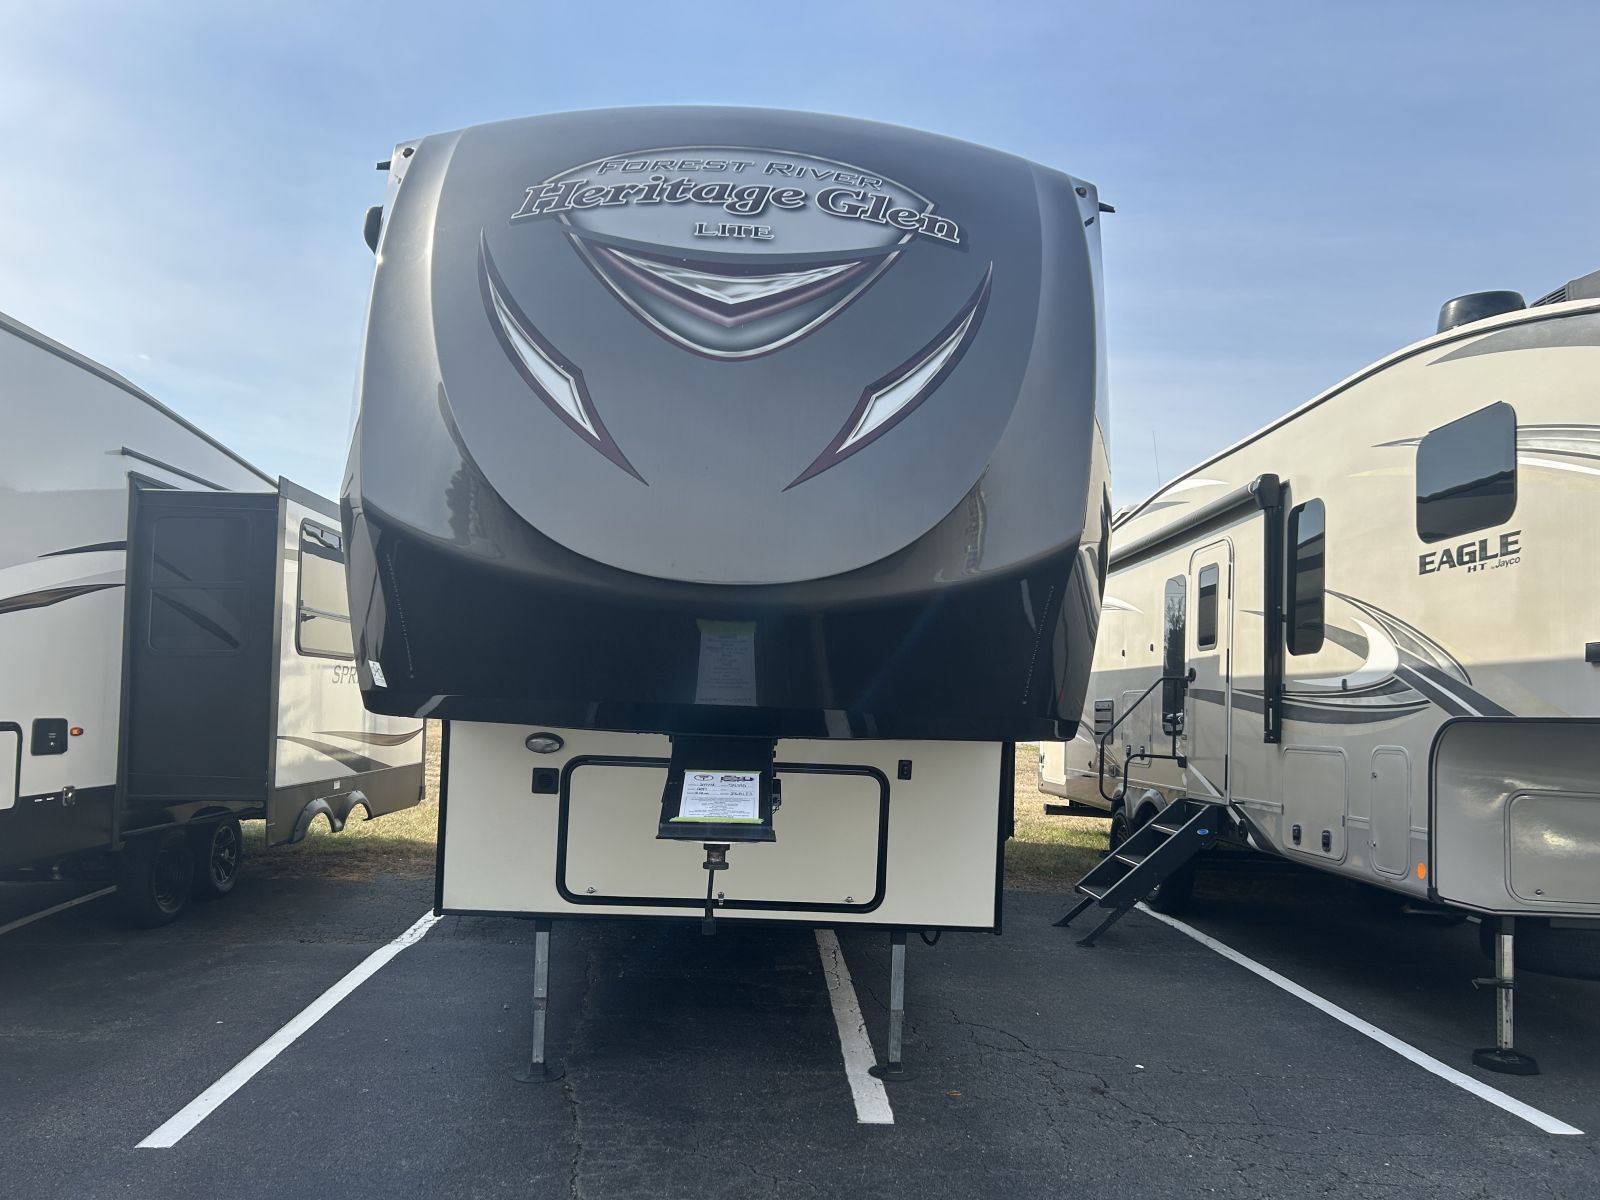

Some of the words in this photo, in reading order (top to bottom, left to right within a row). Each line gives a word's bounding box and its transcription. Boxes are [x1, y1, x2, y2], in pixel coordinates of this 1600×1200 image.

[596, 158, 758, 175] FOREST
[763, 161, 884, 191] RIVER
[510, 174, 807, 220] Heritage
[816, 186, 962, 244] Glen
[694, 222, 774, 241] LITE
[1418, 530, 1522, 575] EAGLE
[1467, 562, 1487, 573] HT
[1495, 556, 1521, 569] Jayco
